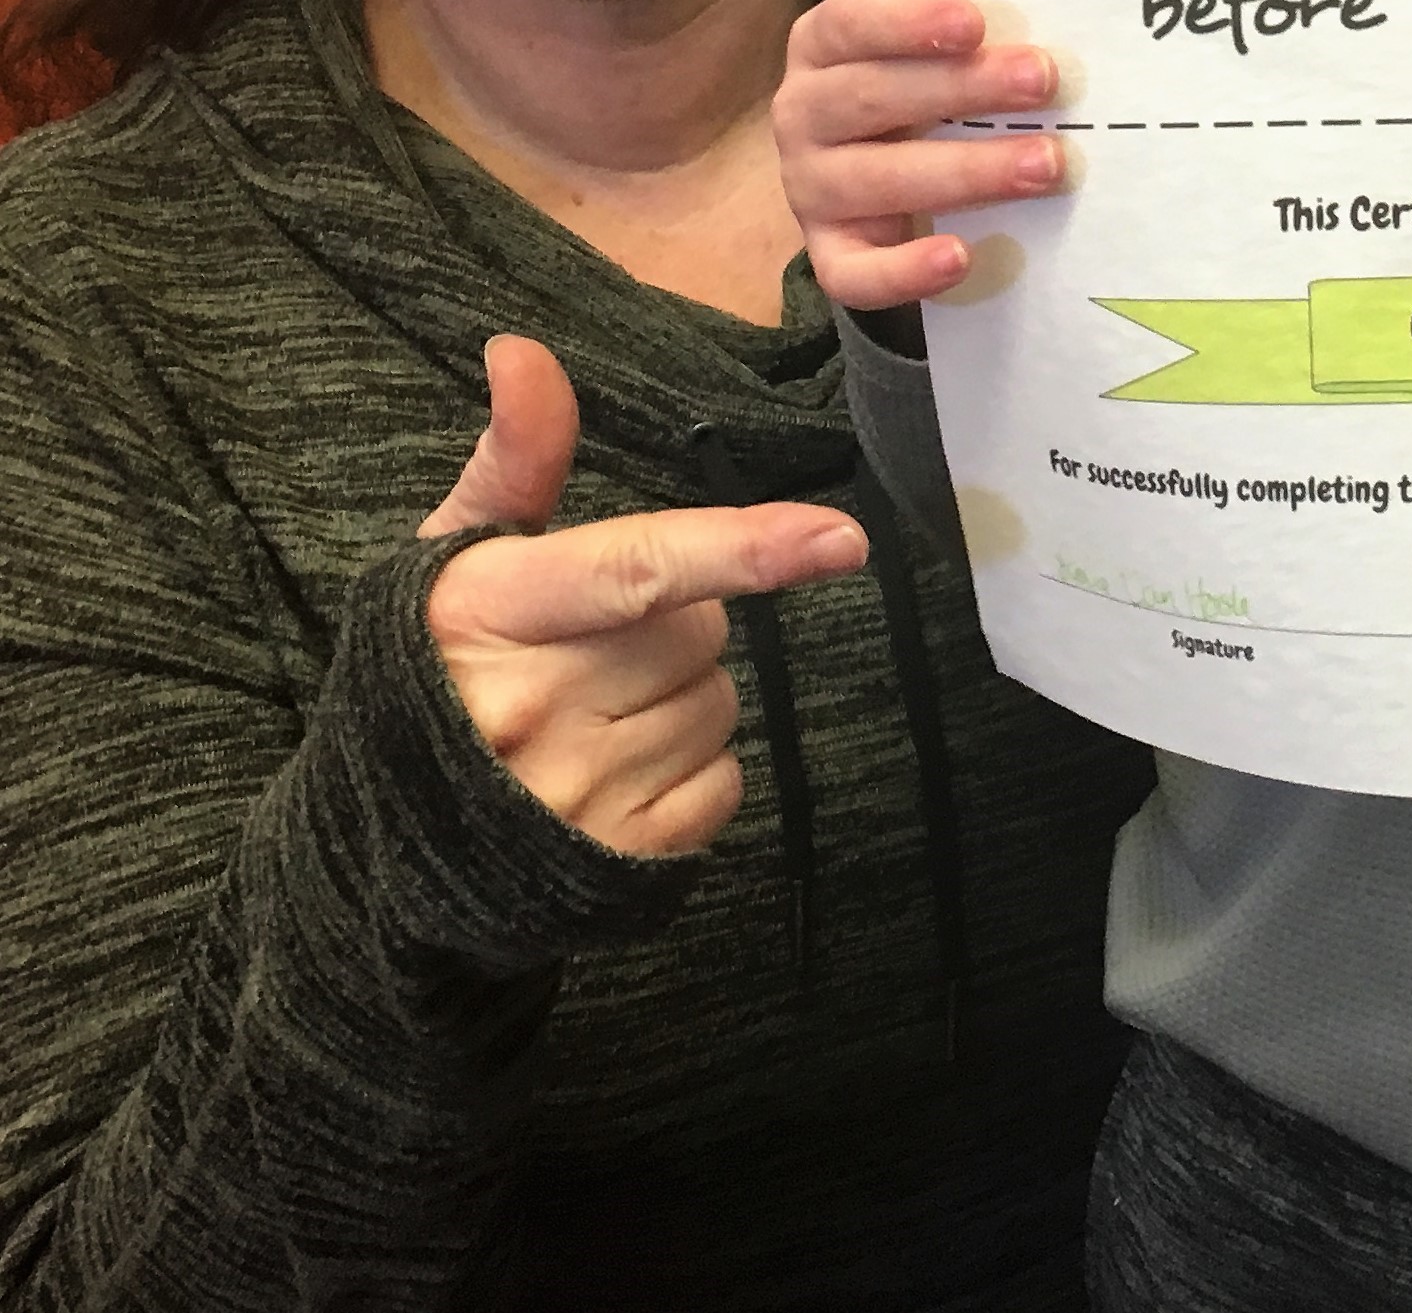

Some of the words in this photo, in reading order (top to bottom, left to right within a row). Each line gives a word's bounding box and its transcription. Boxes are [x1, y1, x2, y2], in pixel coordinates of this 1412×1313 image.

[1273, 196, 1339, 232] This
[1049, 448, 1082, 480] For
[1087, 461, 1229, 510] successfully
[1236, 474, 1390, 513] completing
[1170, 628, 1256, 663] Signature
